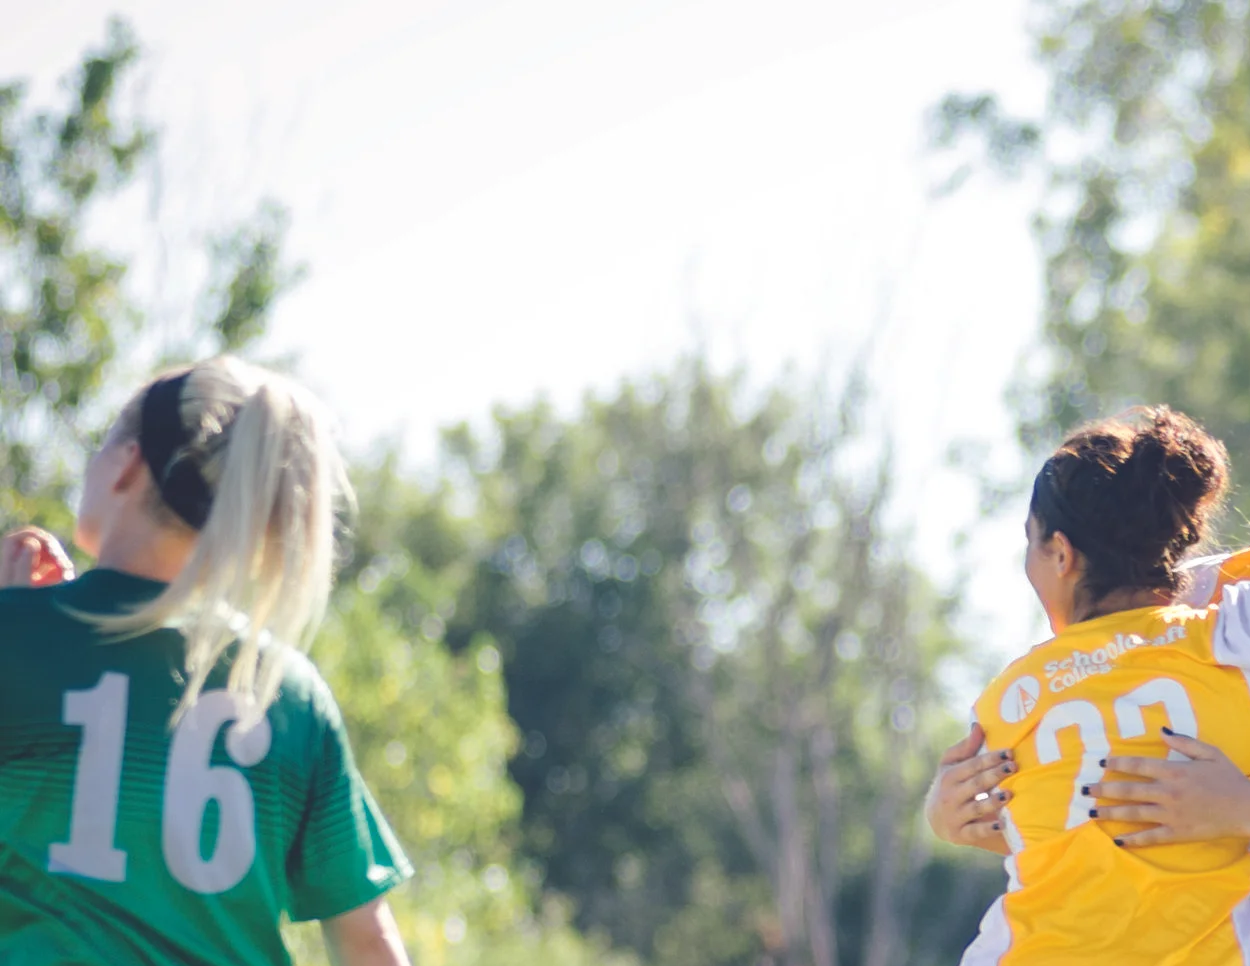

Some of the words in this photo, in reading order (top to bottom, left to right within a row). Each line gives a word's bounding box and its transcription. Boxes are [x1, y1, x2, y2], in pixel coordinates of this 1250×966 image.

[1044, 626, 1186, 678] Schoolcaft
[1050, 663, 1116, 692] Colleg
[47, 671, 272, 894] 16
